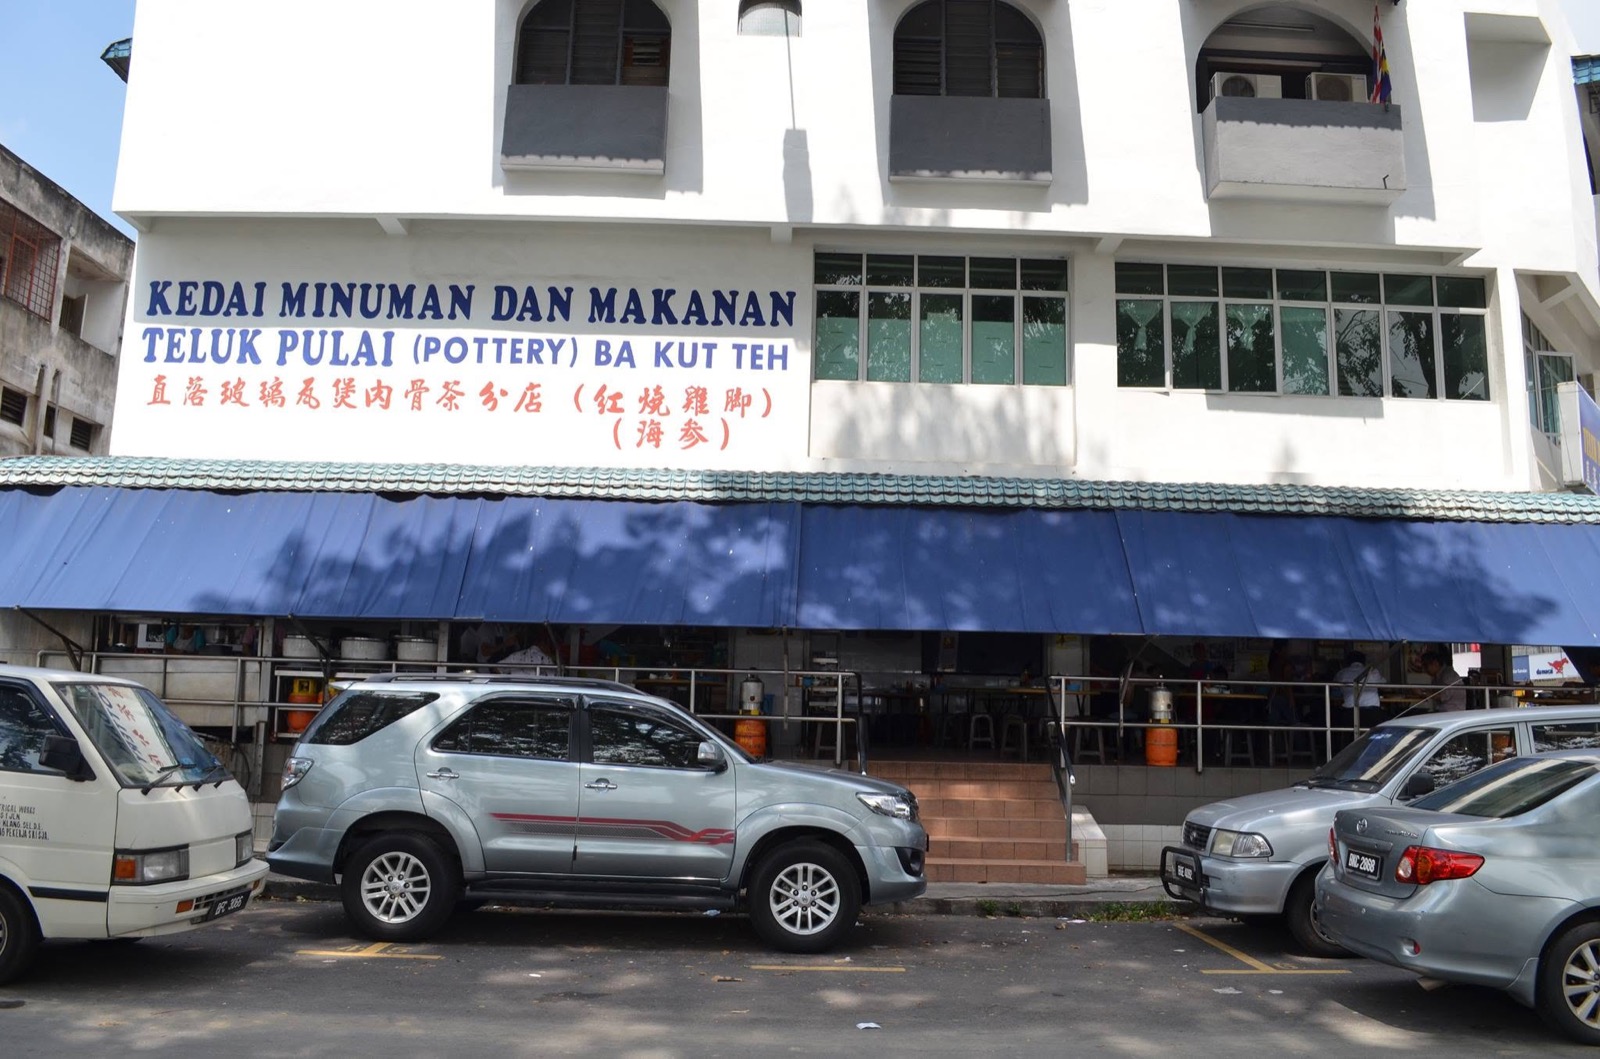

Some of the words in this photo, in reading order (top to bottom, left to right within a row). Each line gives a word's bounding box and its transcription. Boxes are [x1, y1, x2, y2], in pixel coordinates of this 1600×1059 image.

[146, 281, 267, 317] KEDAI
[279, 282, 475, 320] MINUMAN
[491, 285, 574, 322] DAN
[588, 287, 796, 327] MAKANAN
[142, 327, 262, 364] TELUK
[276, 329, 396, 367] PULAI
[413, 334, 578, 368] (POTTERY)
[594, 339, 637, 368] BA
[654, 341, 718, 369] KUT
[732, 343, 789, 371] TEH
